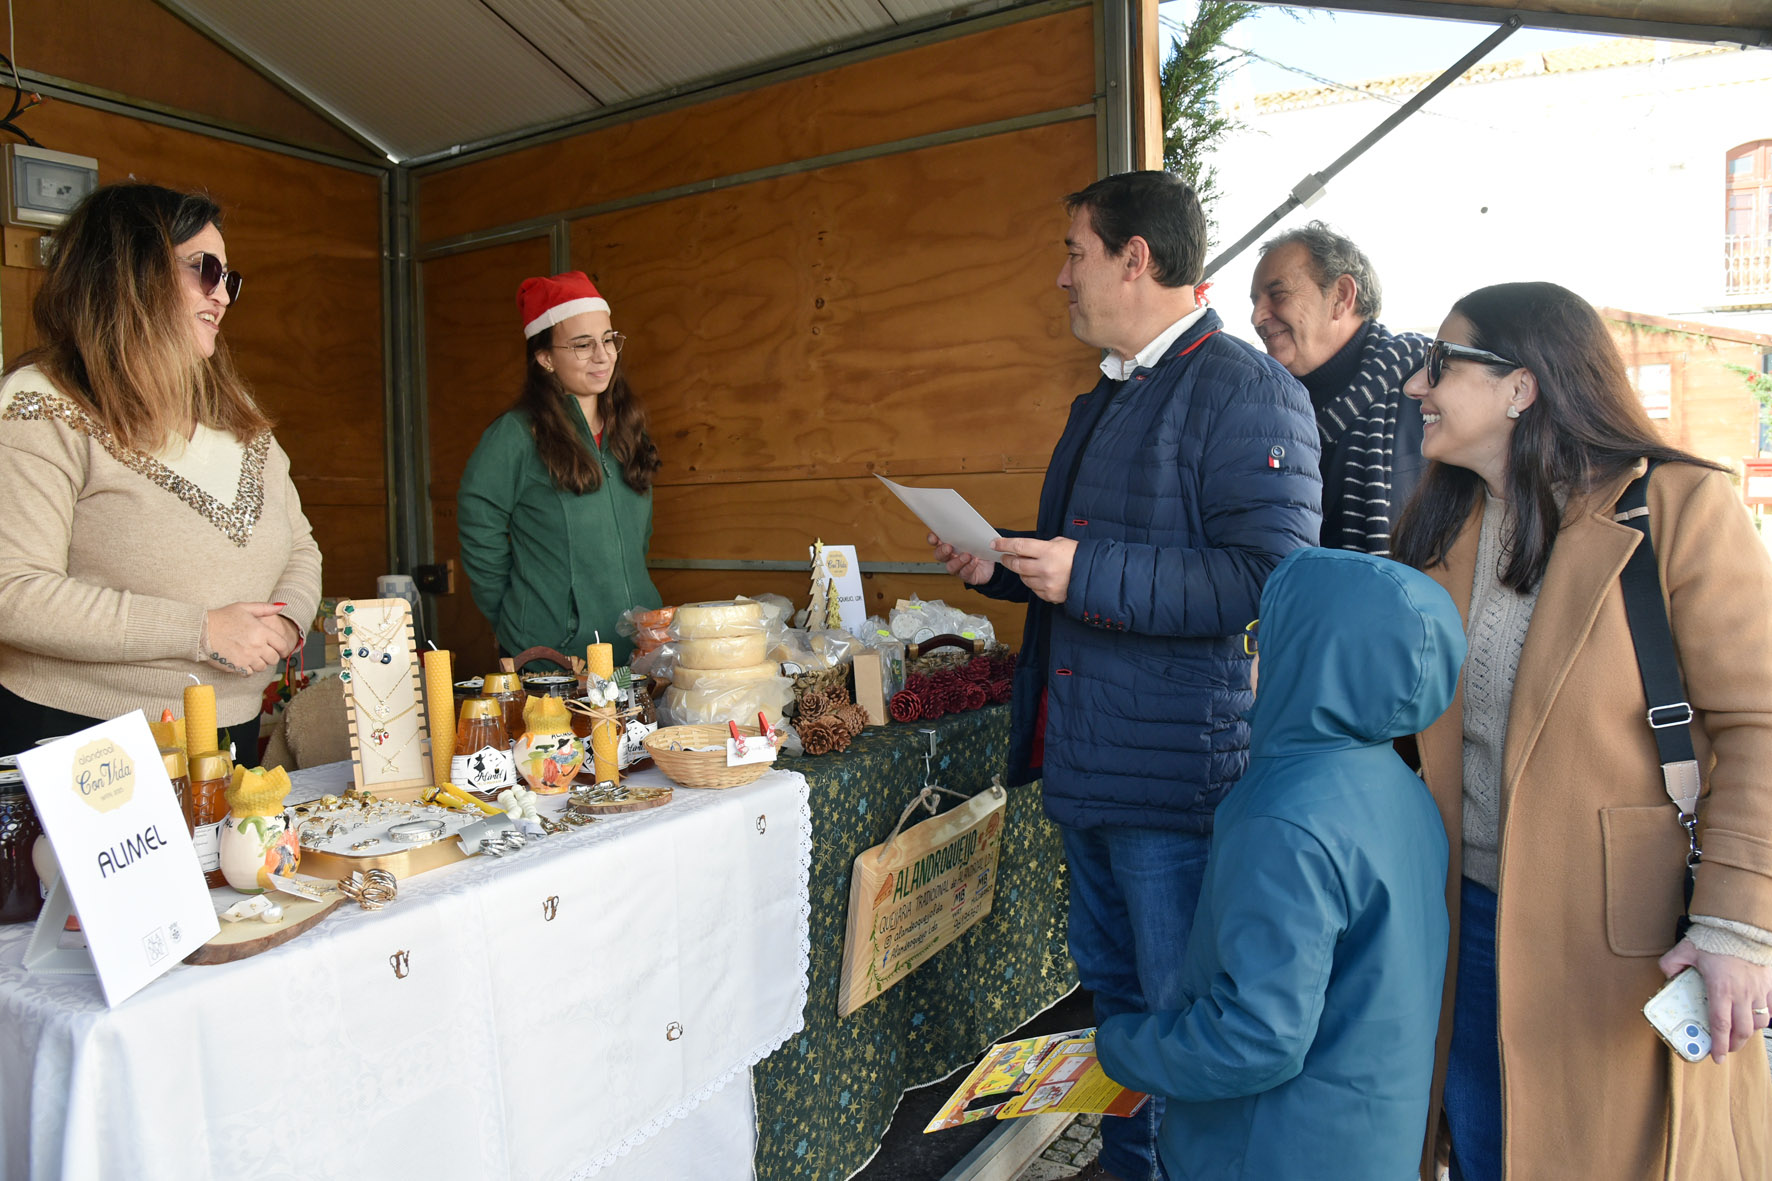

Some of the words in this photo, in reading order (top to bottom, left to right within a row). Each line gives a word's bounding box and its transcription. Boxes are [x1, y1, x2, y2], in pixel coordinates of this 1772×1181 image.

[78, 743, 114, 766] alandroal
[98, 824, 167, 879] ALIMEL
[977, 872, 989, 889] MB
[953, 888, 966, 907] MB
